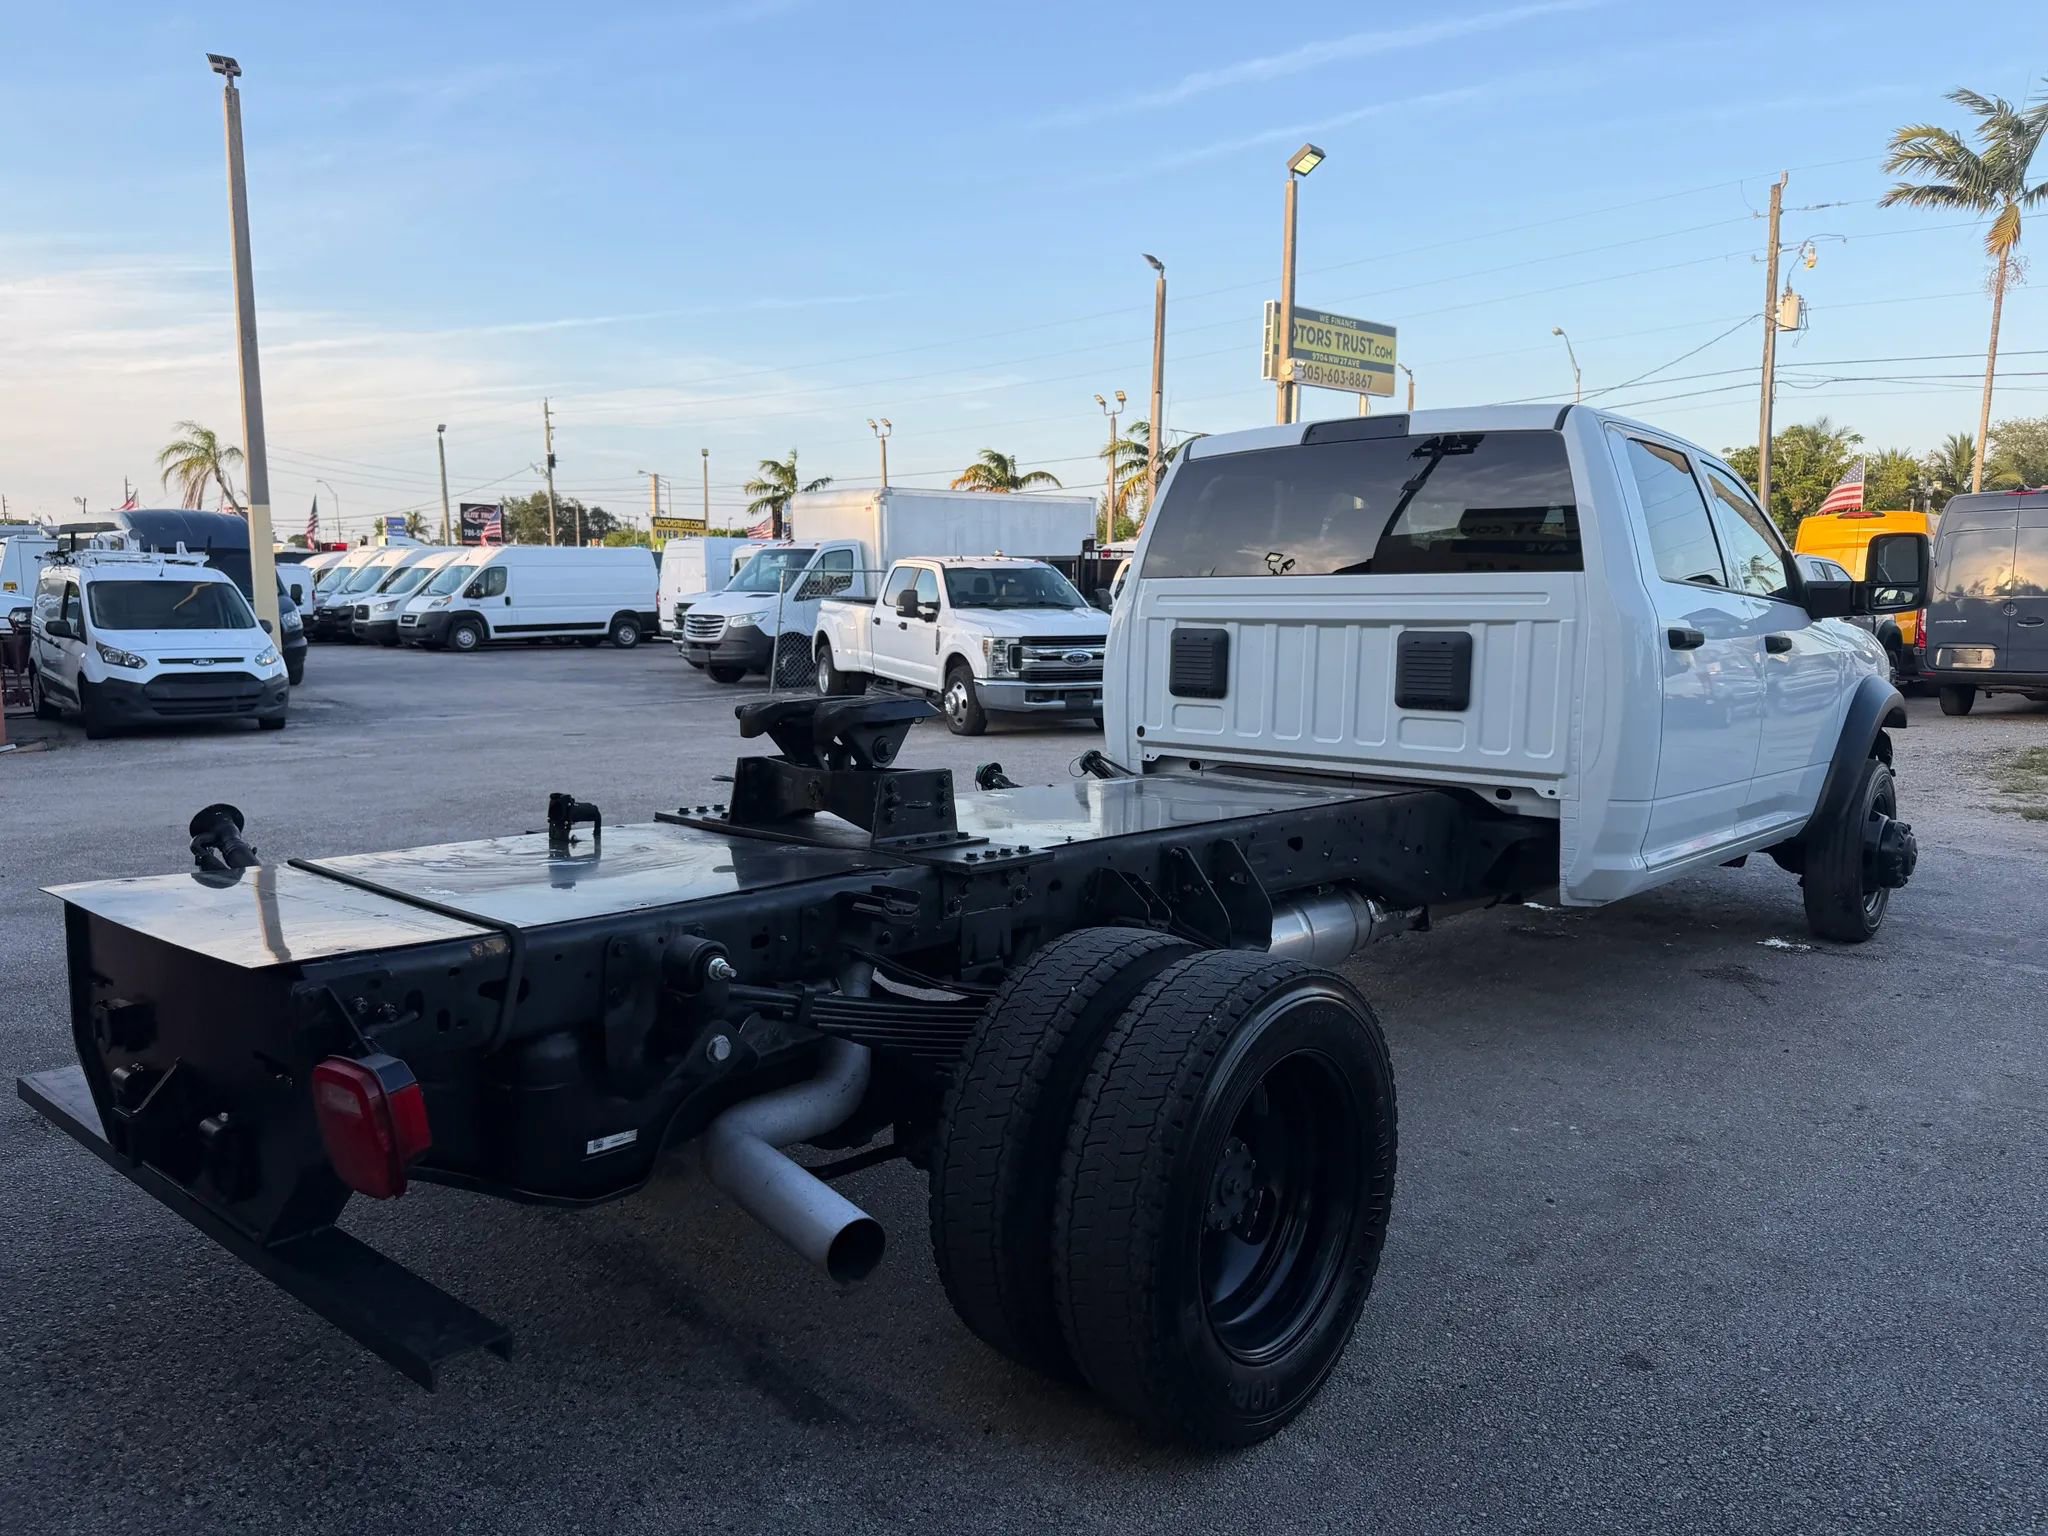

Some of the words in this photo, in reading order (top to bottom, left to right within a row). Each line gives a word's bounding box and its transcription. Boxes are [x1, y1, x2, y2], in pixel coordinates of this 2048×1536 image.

[1320, 314, 1329, 324] WE
[1330, 316, 1357, 329] FINANCE
[1328, 355, 1339, 364] NW
[1340, 357, 1347, 365] 27
[1348, 359, 1360, 368] AVE
[656, 529, 679, 540] OVER
